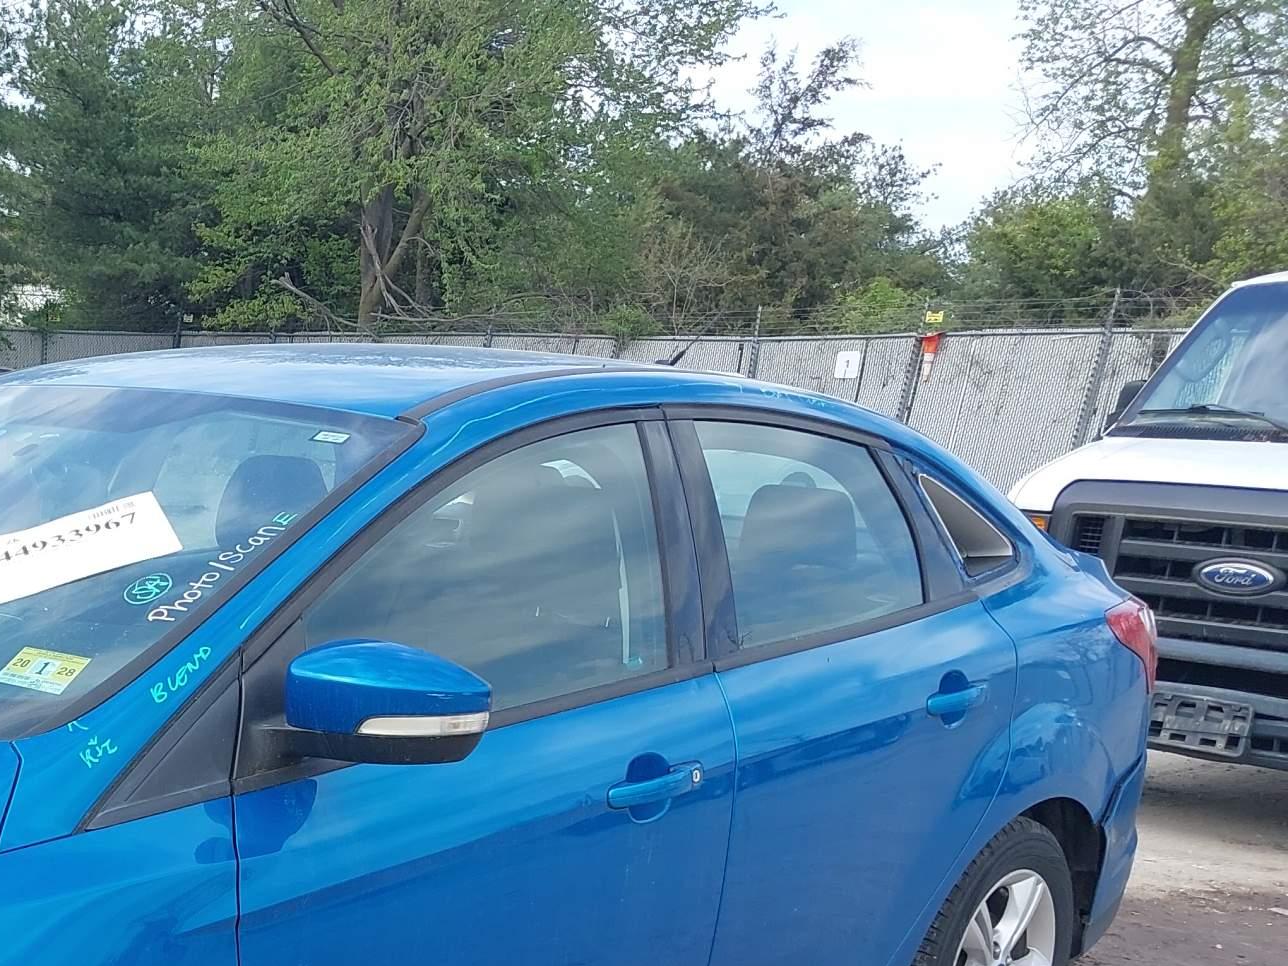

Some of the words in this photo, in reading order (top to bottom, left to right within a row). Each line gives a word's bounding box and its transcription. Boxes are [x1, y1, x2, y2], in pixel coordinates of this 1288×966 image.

[1214, 567, 1257, 585] Ford
[12, 657, 31, 668] 20
[56, 666, 76, 677] 28
[150, 646, 212, 703] BLEND
